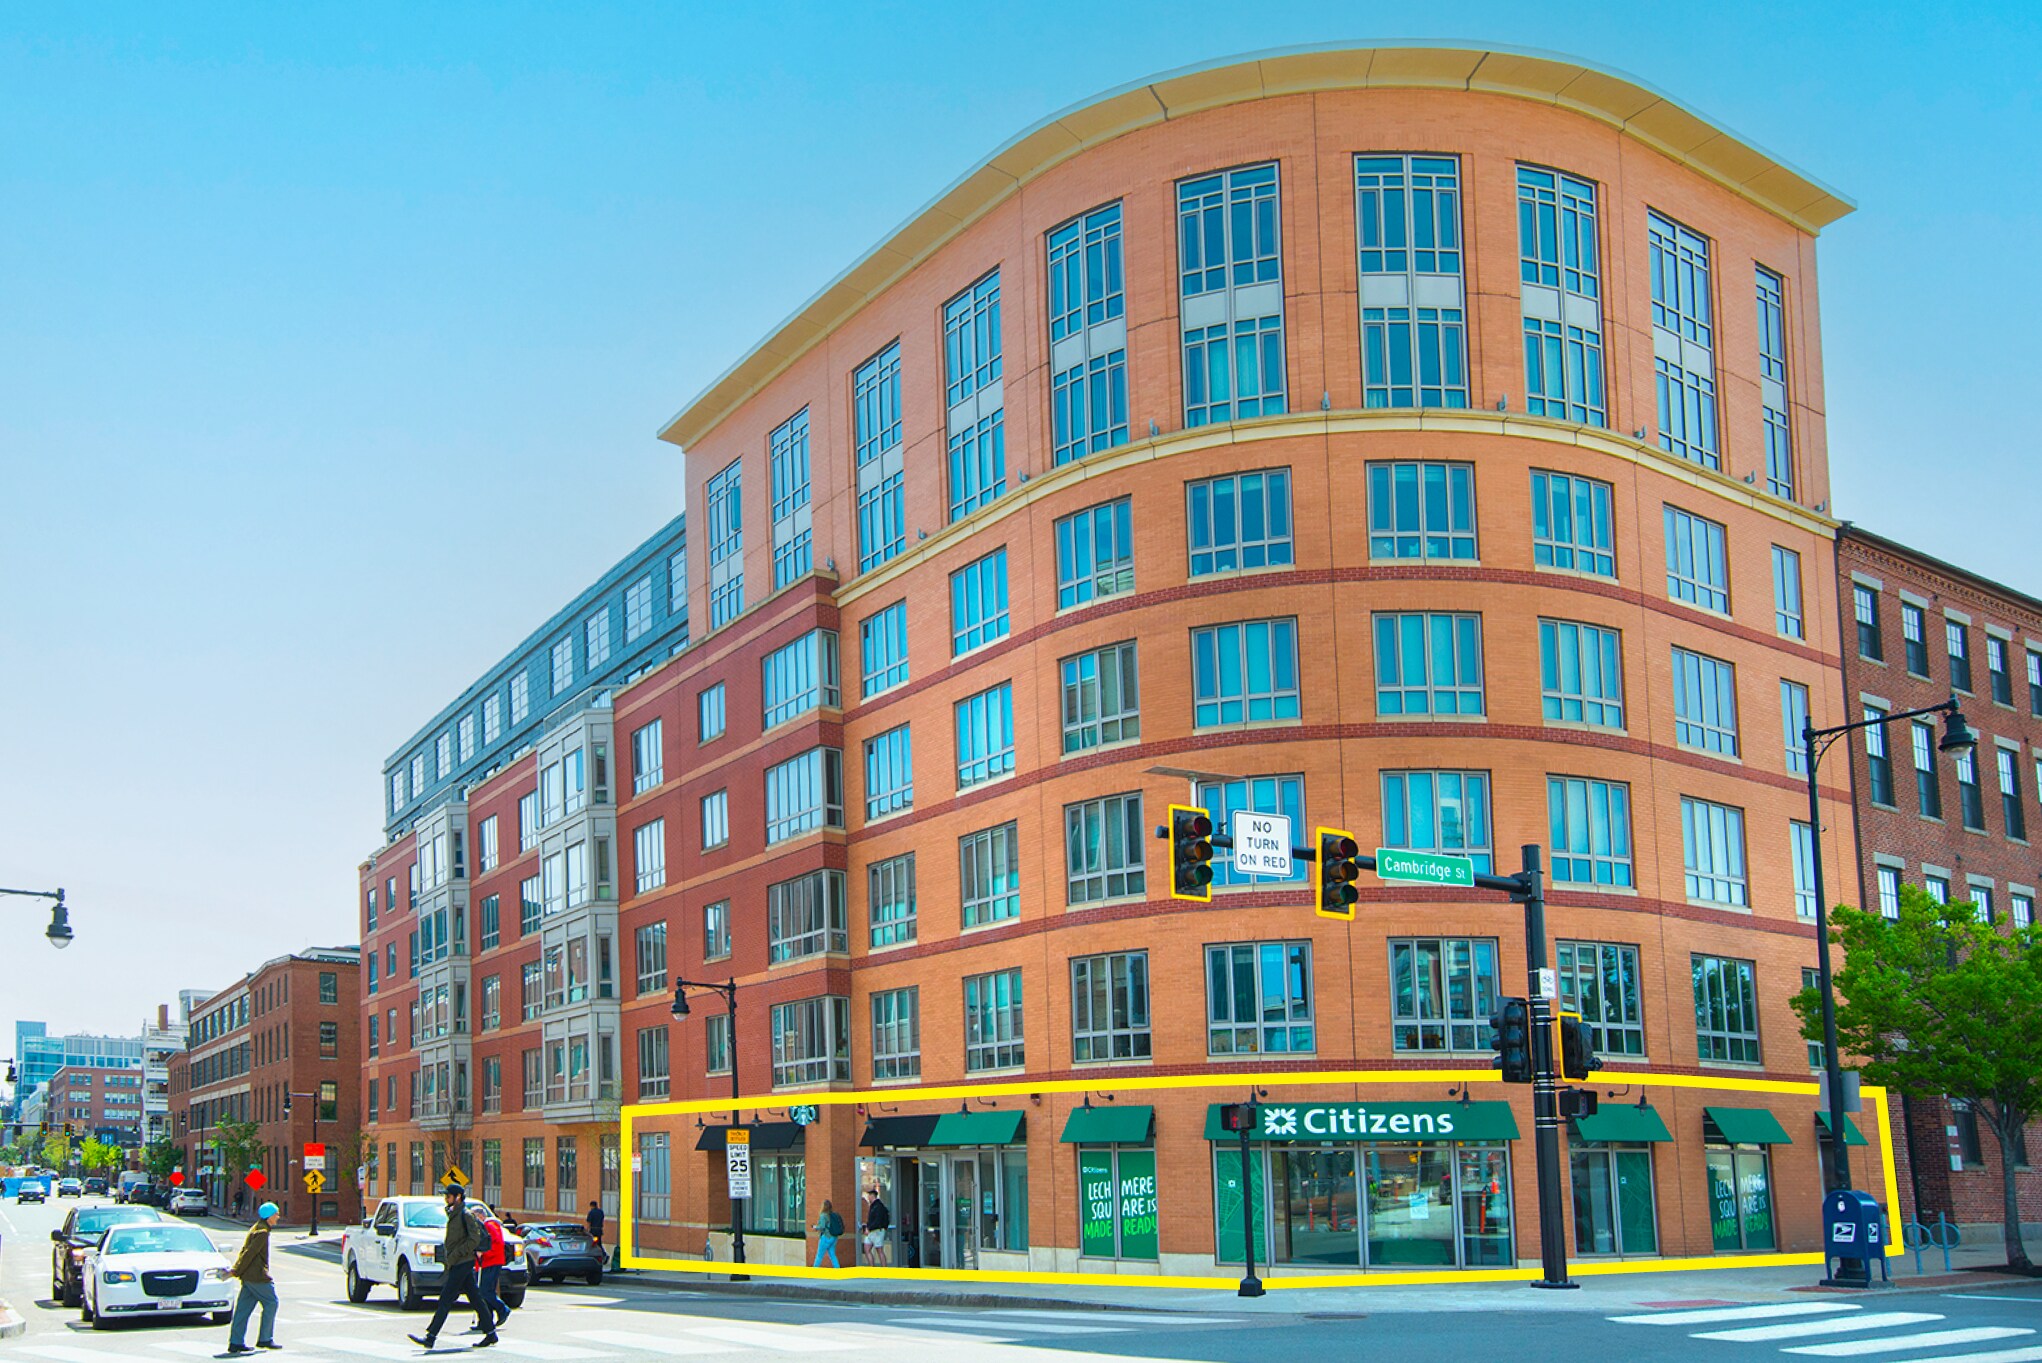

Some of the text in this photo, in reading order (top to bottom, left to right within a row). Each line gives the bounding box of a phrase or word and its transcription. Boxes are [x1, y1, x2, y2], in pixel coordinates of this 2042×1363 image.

[1252, 821, 1272, 833] NO
[1246, 836, 1279, 850] TURN
[1240, 854, 1287, 869] ON RED
[1384, 856, 1466, 881] Cambridge St
[1303, 1108, 1454, 1134] Citizens
[730, 1160, 748, 1172] 25
[1088, 1176, 1154, 1200] LECH MERE
[1091, 1198, 1157, 1220] SQU ARE IS
[1084, 1215, 1158, 1239] MADE READY
